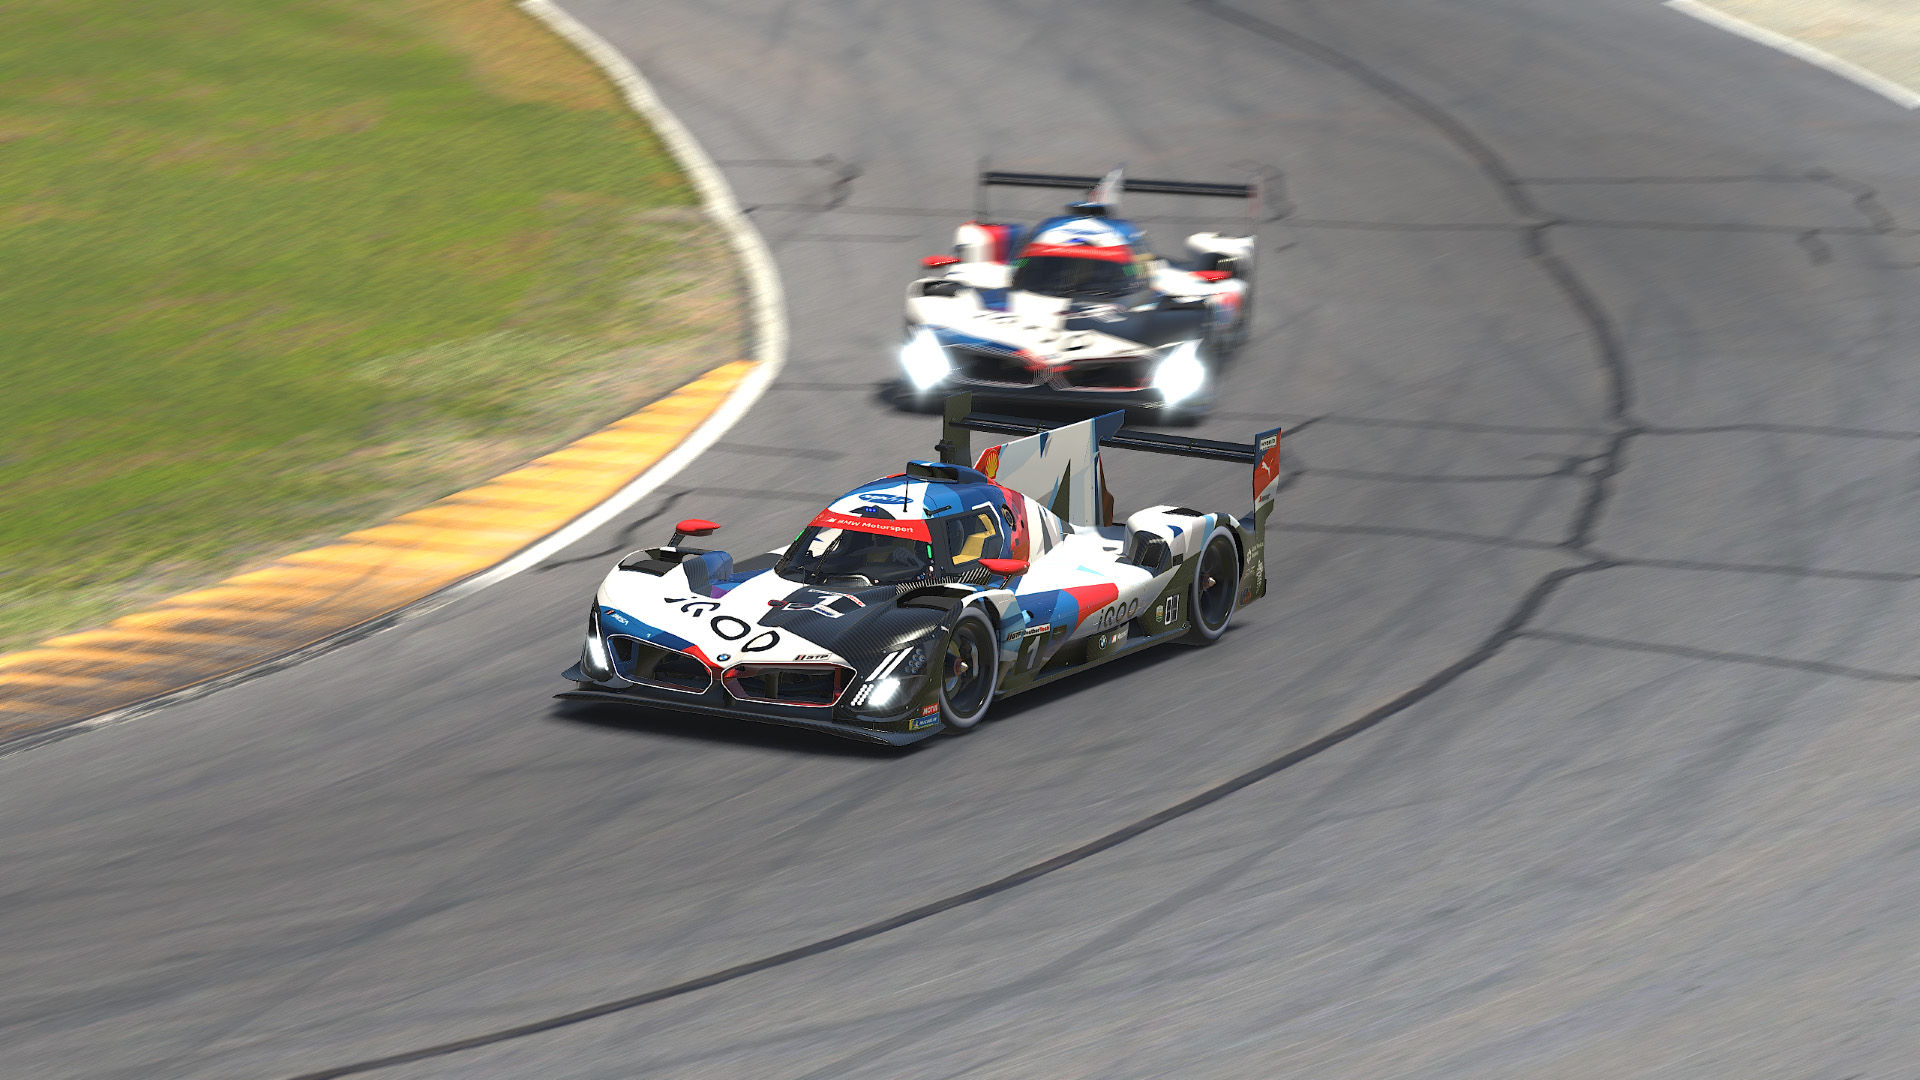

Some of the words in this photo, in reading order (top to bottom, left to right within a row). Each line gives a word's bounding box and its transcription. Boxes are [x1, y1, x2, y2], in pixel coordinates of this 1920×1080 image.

[837, 519, 861, 527] BMW
[862, 522, 914, 533] Motorsport
[1027, 635, 1041, 670] 1
